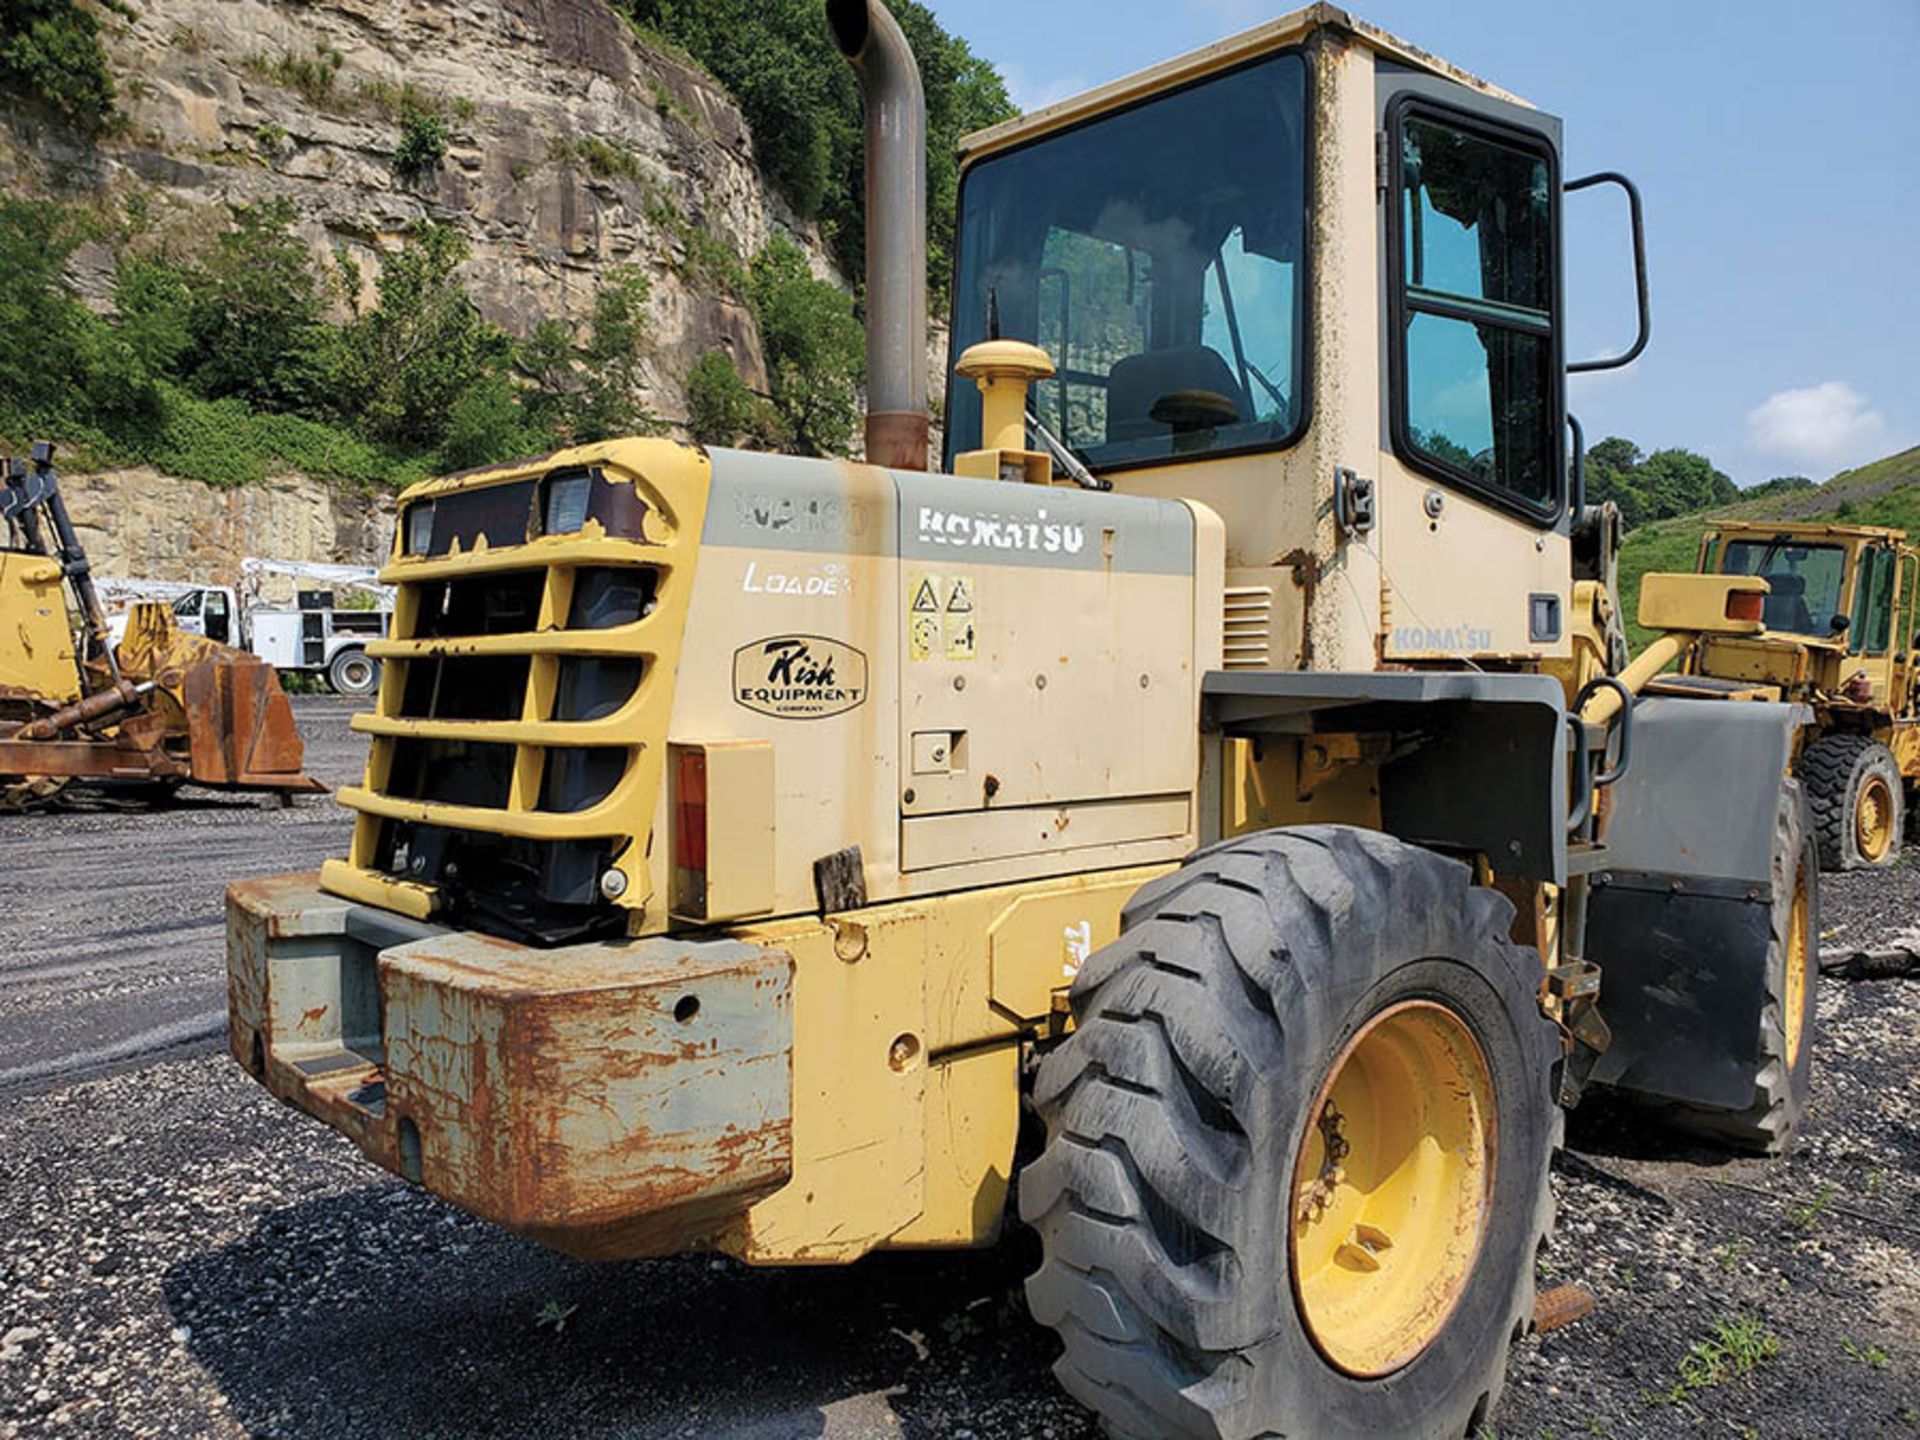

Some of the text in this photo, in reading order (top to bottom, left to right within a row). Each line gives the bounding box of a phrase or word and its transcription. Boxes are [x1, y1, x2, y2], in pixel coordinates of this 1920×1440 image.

[918, 507, 1084, 553] KOMATSU
[1394, 624, 1491, 650] KOMATSU
[740, 688, 862, 705] EQUIPMENT
[776, 705, 824, 713] COMPANY
